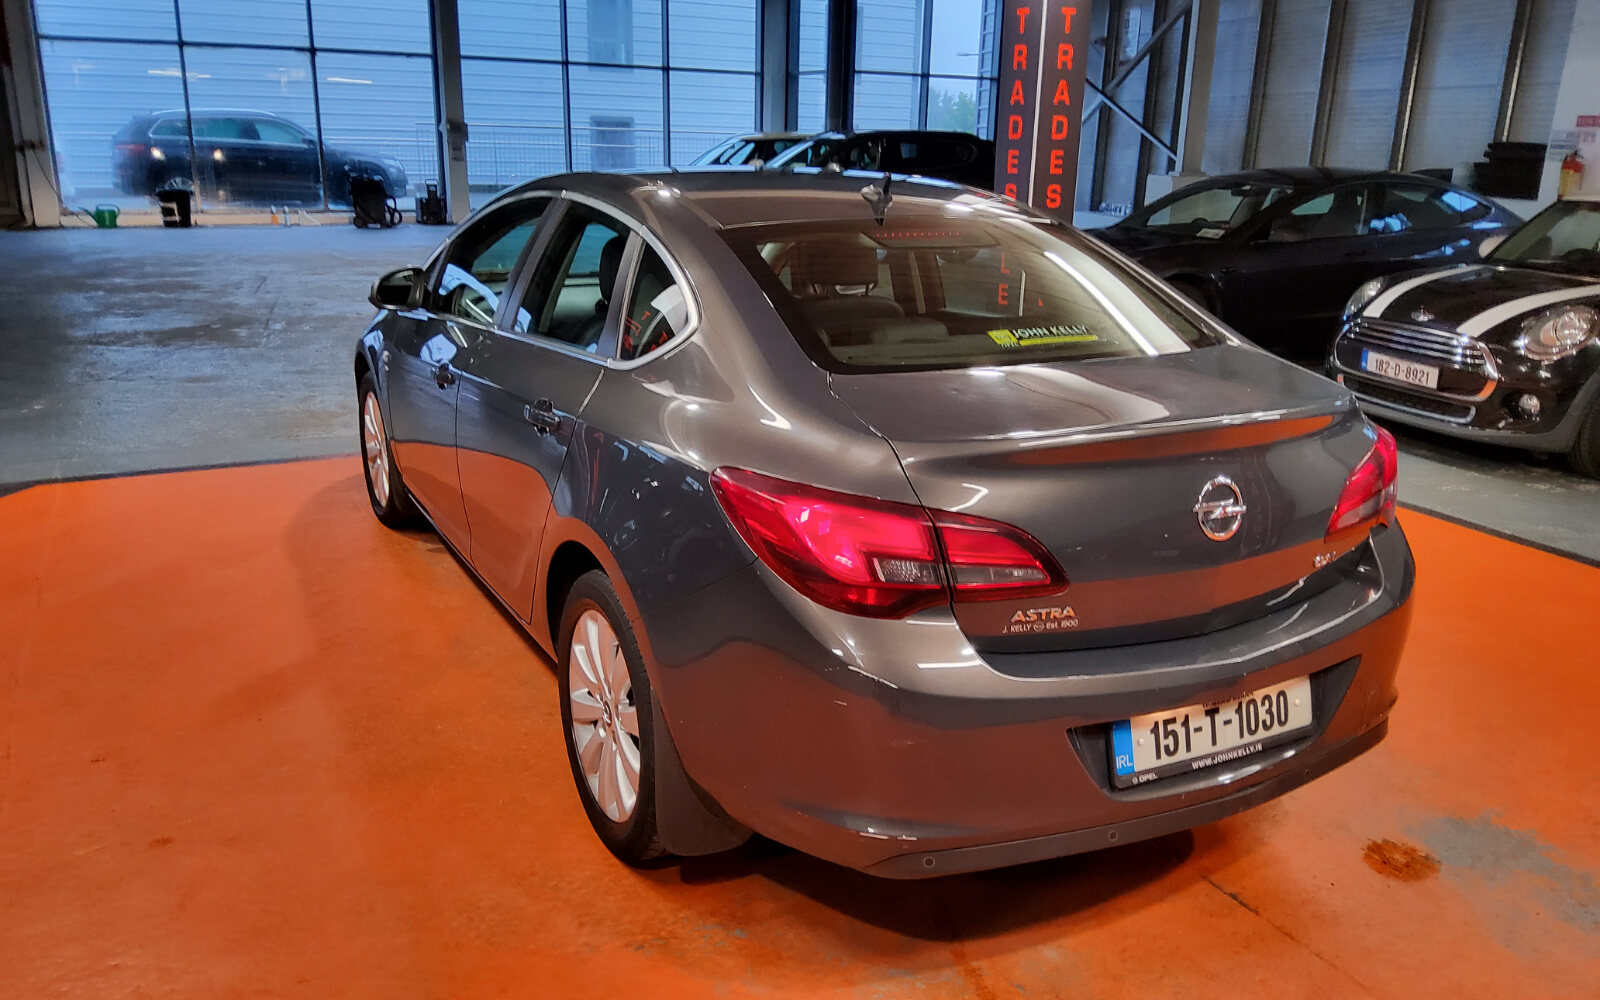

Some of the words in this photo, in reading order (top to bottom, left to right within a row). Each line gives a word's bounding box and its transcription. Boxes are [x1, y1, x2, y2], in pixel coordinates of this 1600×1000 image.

[1005, 6, 1030, 207] TRADES
[1046, 6, 1077, 209] TRADES
[1012, 327, 1050, 339] JOHN
[1050, 325, 1089, 336] KELLY
[1375, 358, 1430, 385] 182-D-8921
[1011, 606, 1076, 622] ASTRA
[1010, 623, 1032, 633] KELLY
[1150, 690, 1289, 761] 151-T-1030
[1116, 754, 1133, 769] IRL
